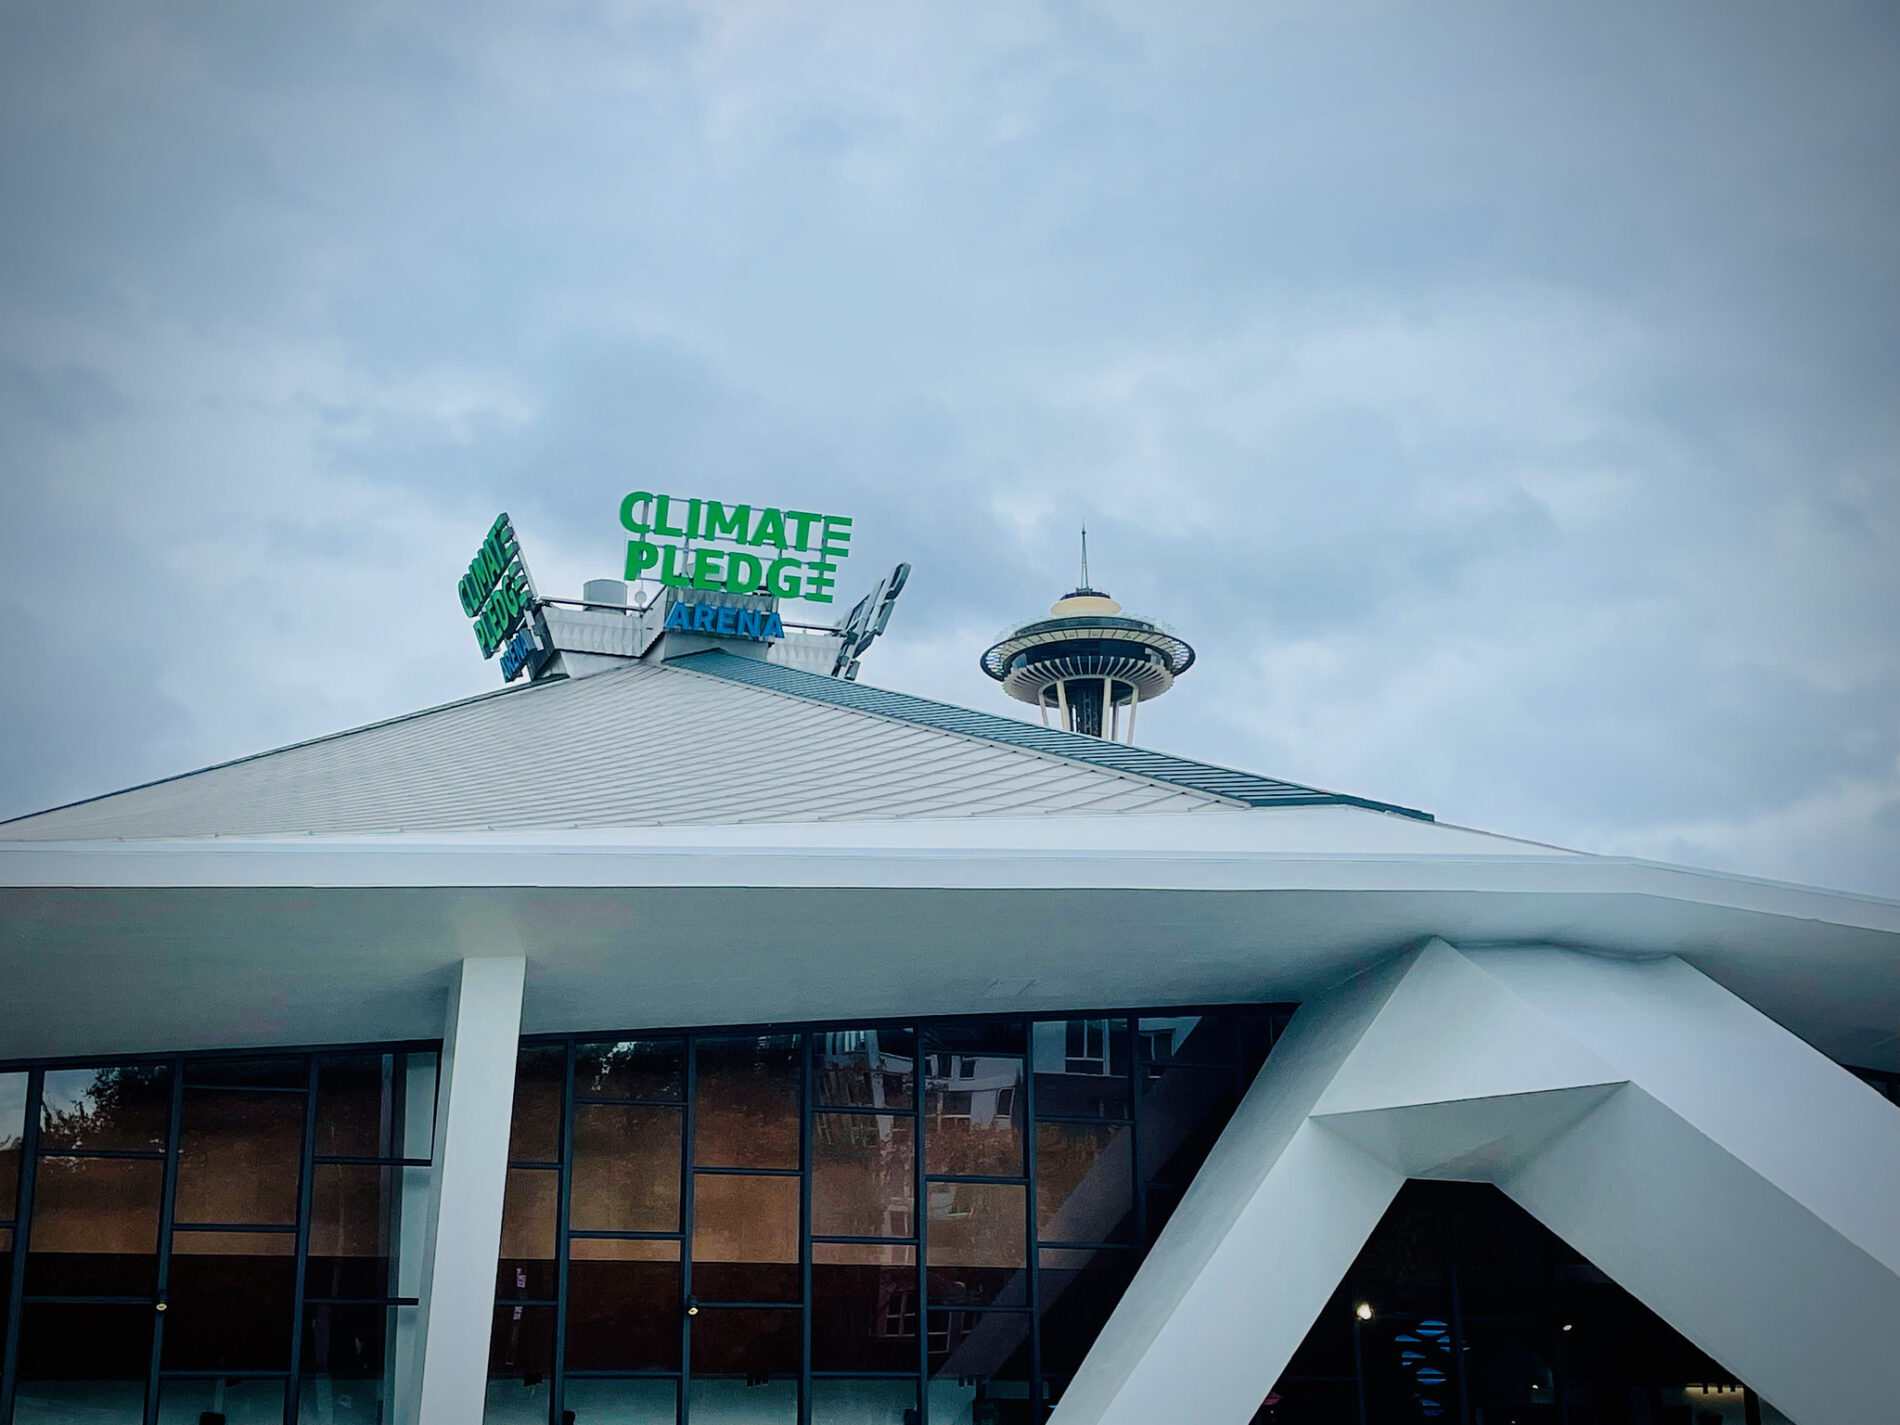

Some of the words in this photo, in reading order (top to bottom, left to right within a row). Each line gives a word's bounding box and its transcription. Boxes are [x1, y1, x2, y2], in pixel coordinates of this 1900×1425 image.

[619, 490, 853, 557] CLIMATE
[458, 512, 520, 618] CLIMATE
[623, 540, 837, 603] PLEDGE
[473, 560, 533, 661] PLEDGE
[664, 602, 785, 639] ARENA
